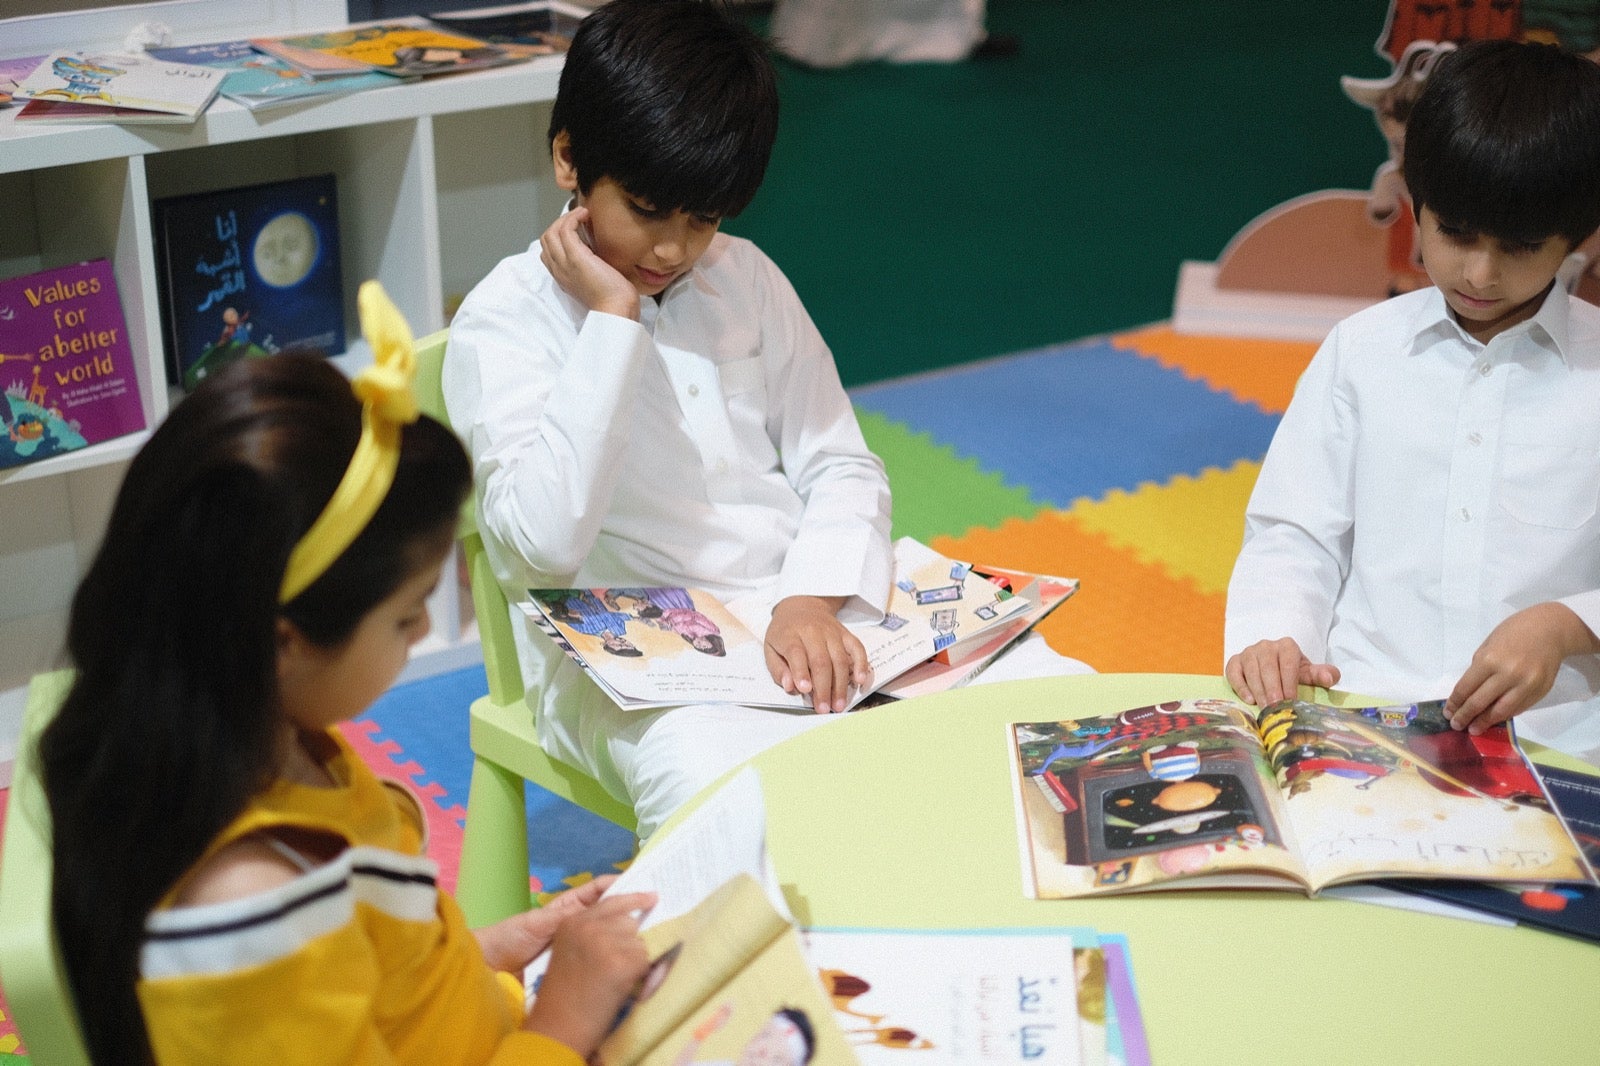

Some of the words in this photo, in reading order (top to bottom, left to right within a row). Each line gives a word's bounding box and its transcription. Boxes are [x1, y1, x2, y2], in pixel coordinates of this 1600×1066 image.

[24, 277, 101, 308] Values
[53, 307, 87, 329] for
[54, 351, 115, 386] world
